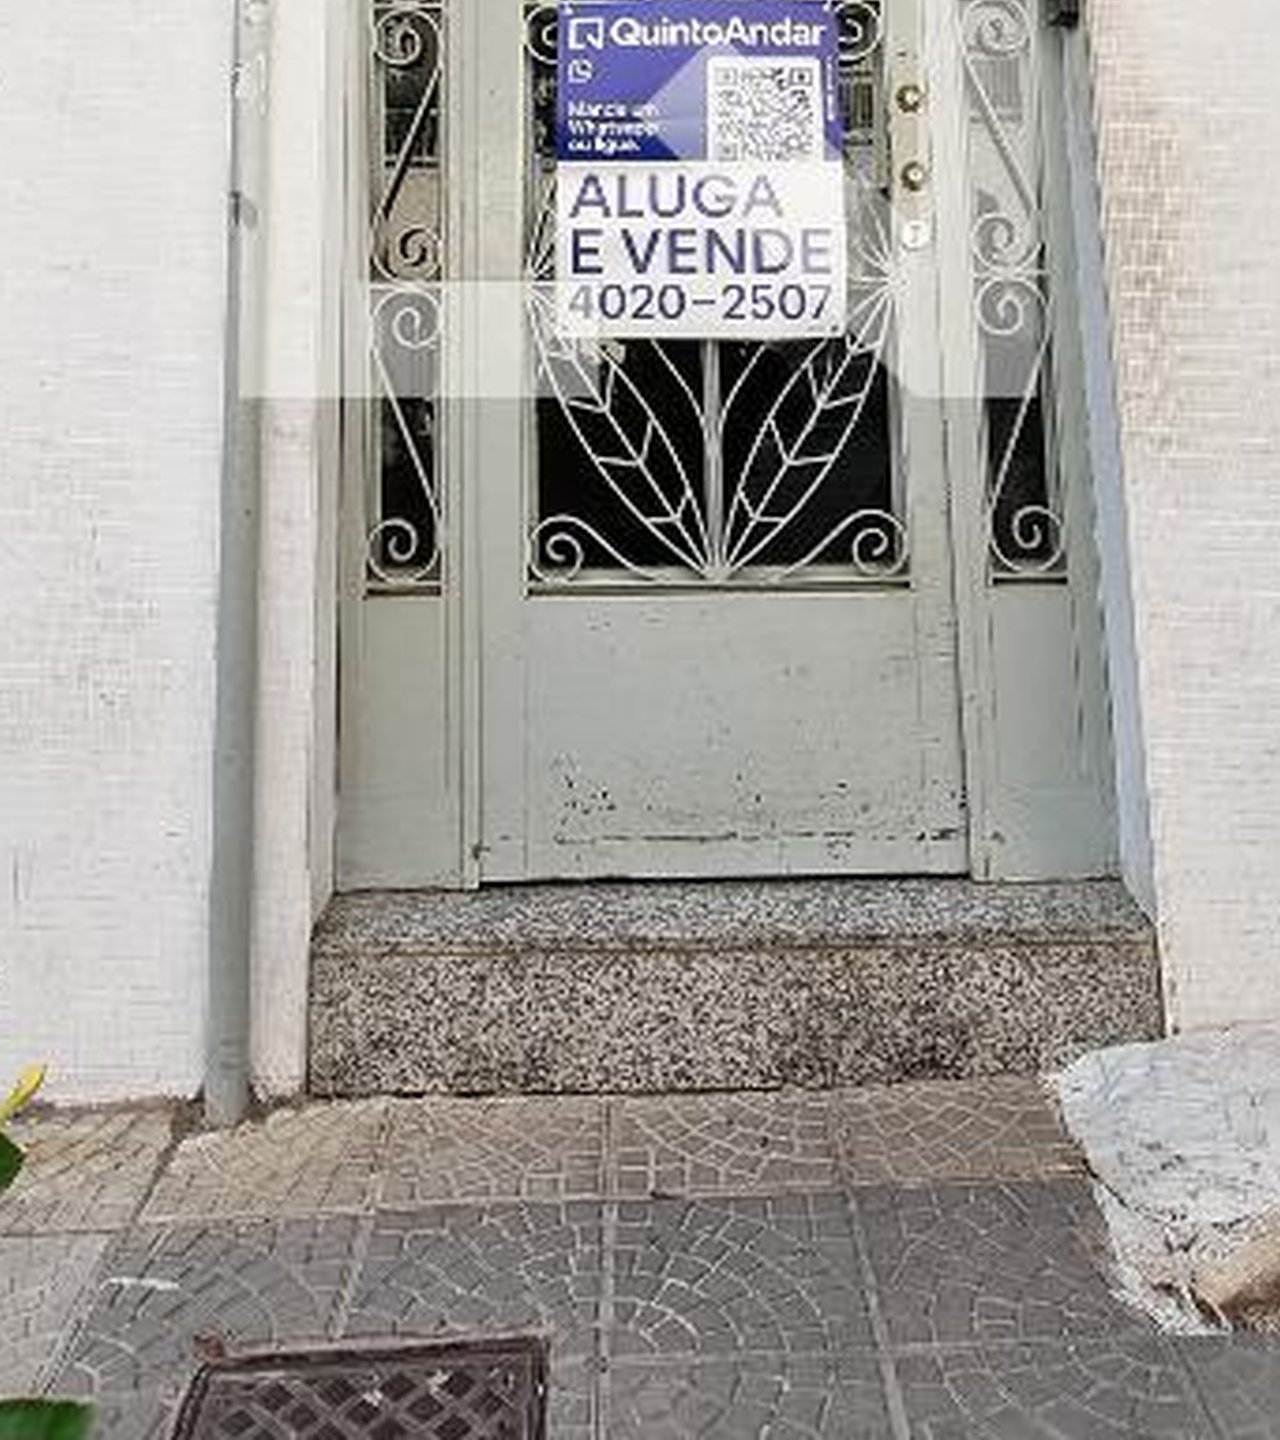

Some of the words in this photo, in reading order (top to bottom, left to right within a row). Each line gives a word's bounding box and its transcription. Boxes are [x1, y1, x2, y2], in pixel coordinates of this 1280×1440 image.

[609, 16, 827, 47] QuintoAndar
[568, 173, 784, 219] ALUGA
[571, 228, 604, 275] E
[620, 228, 833, 275] VENDE
[568, 283, 833, 321] 4020-2507
